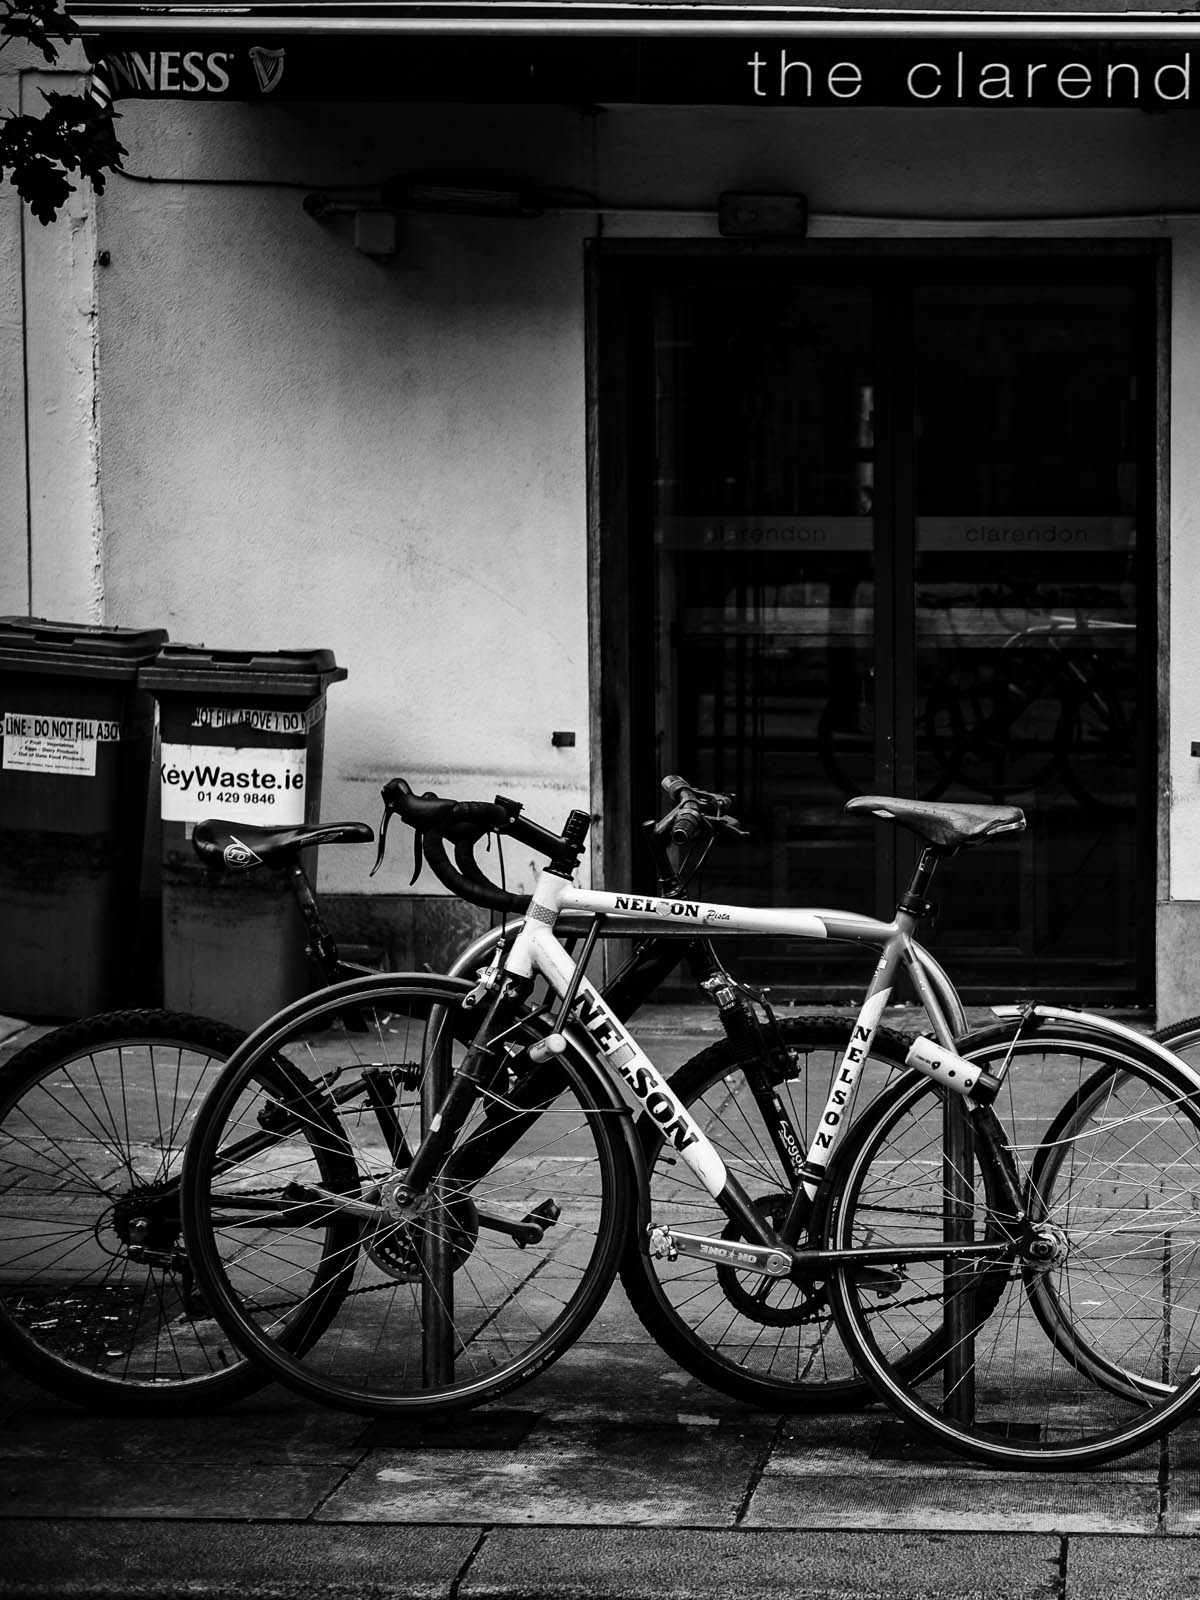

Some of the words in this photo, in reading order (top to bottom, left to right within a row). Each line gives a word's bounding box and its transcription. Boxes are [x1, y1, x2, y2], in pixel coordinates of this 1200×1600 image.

[747, 49, 862, 98] the
[707, 525, 827, 543] larendon
[966, 525, 1088, 543] clarendon
[35, 720, 49, 737] DO
[52, 721, 73, 738] NOT
[76, 722, 94, 739] FILL
[283, 714, 298, 730] DO
[198, 791, 212, 802] 01
[216, 792, 240, 803] 429
[243, 793, 275, 804] 9846
[614, 896, 700, 918] NELON
[571, 988, 700, 1153] NESON
[814, 1025, 872, 1149] NELSON
